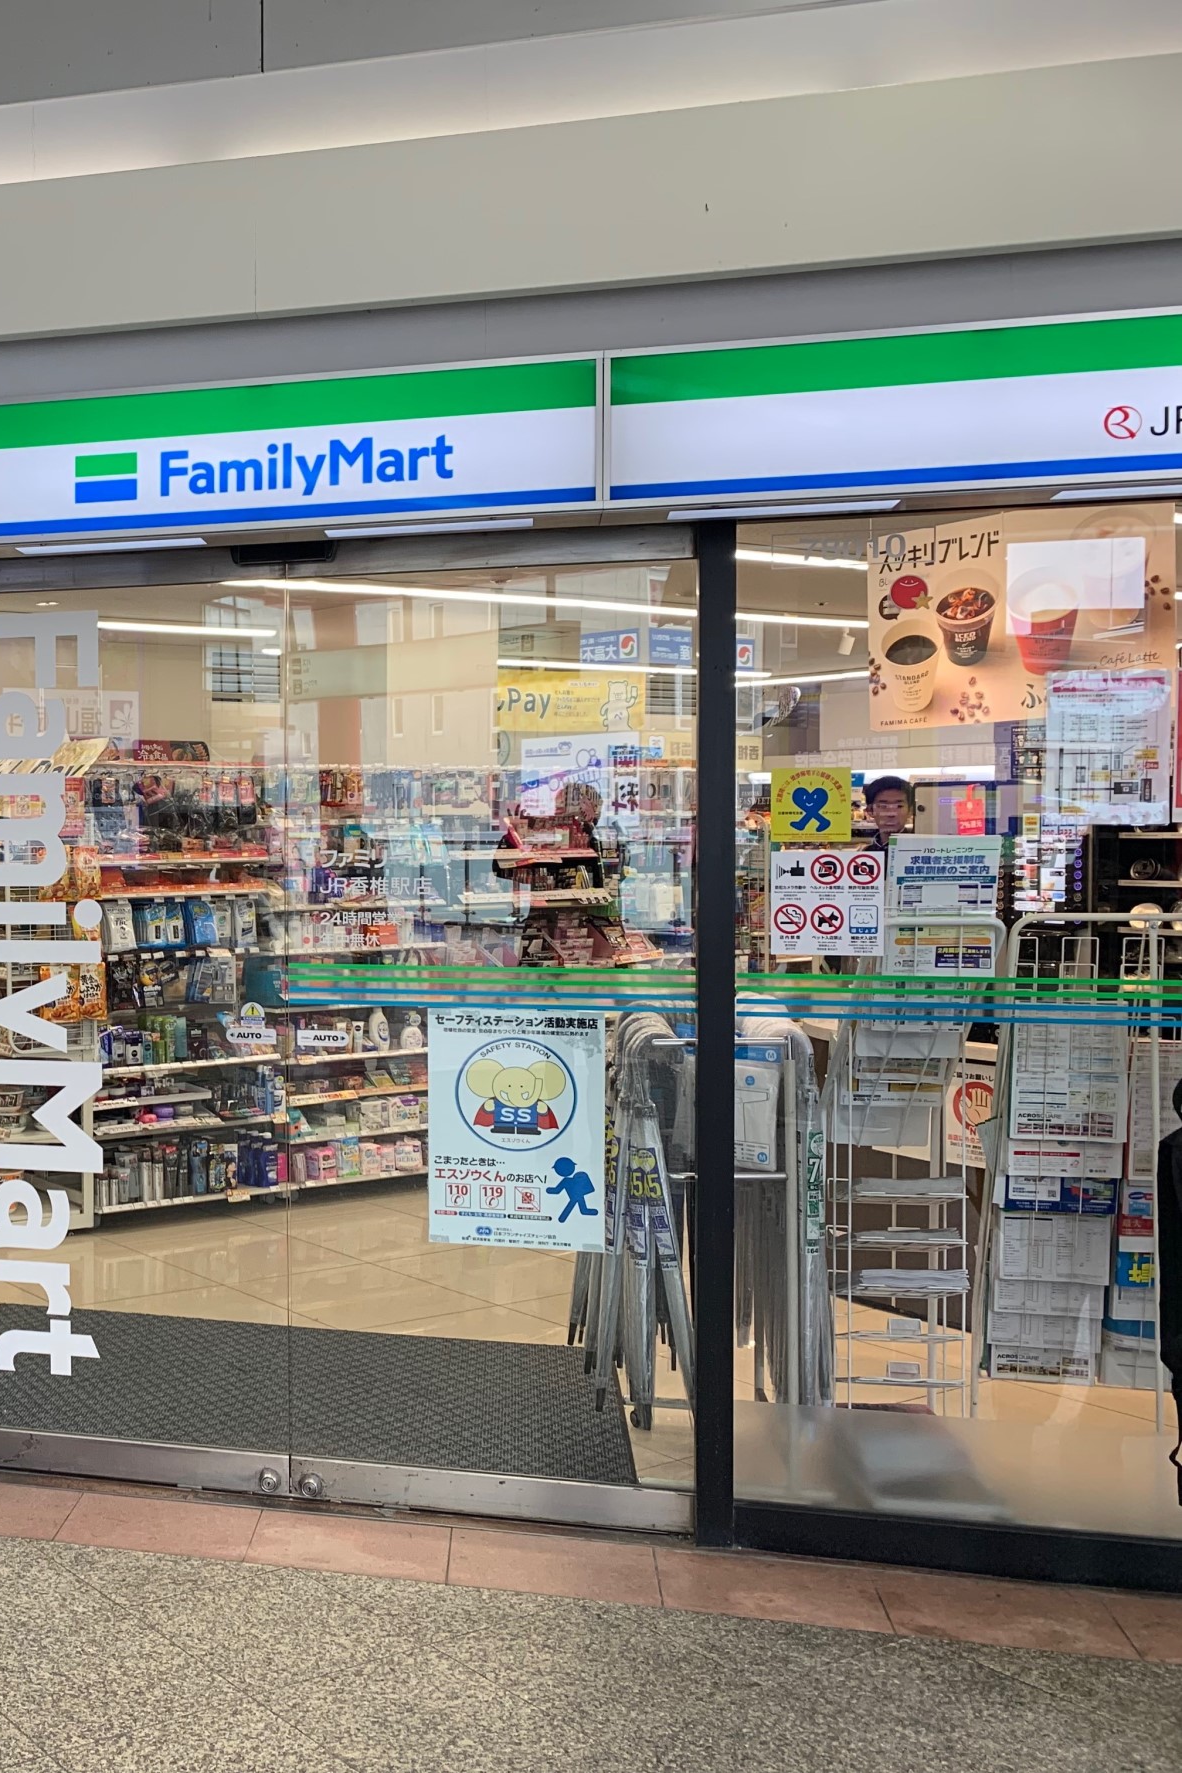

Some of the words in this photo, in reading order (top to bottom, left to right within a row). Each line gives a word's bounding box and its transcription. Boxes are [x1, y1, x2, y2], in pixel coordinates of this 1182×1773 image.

[159, 434, 454, 497] FamilyMart
[1099, 652, 1127, 667] Café
[1127, 650, 1159, 664] Latte
[880, 718, 909, 727] FAMIMA
[910, 855, 986, 865] 求職者支援制度
[904, 865, 990, 875] 職業訓練のご案内
[319, 876, 433, 896] JR香椎駅店
[320, 911, 402, 926] 24時間営業
[320, 933, 381, 947] 年中無休
[435, 1014, 599, 1029] セーフティステーション活動実施店
[479, 1041, 512, 1058] SAFETY
[514, 1041, 551, 1059] STATION
[447, 1184, 468, 1196] 110
[482, 1186, 503, 1197] 119
